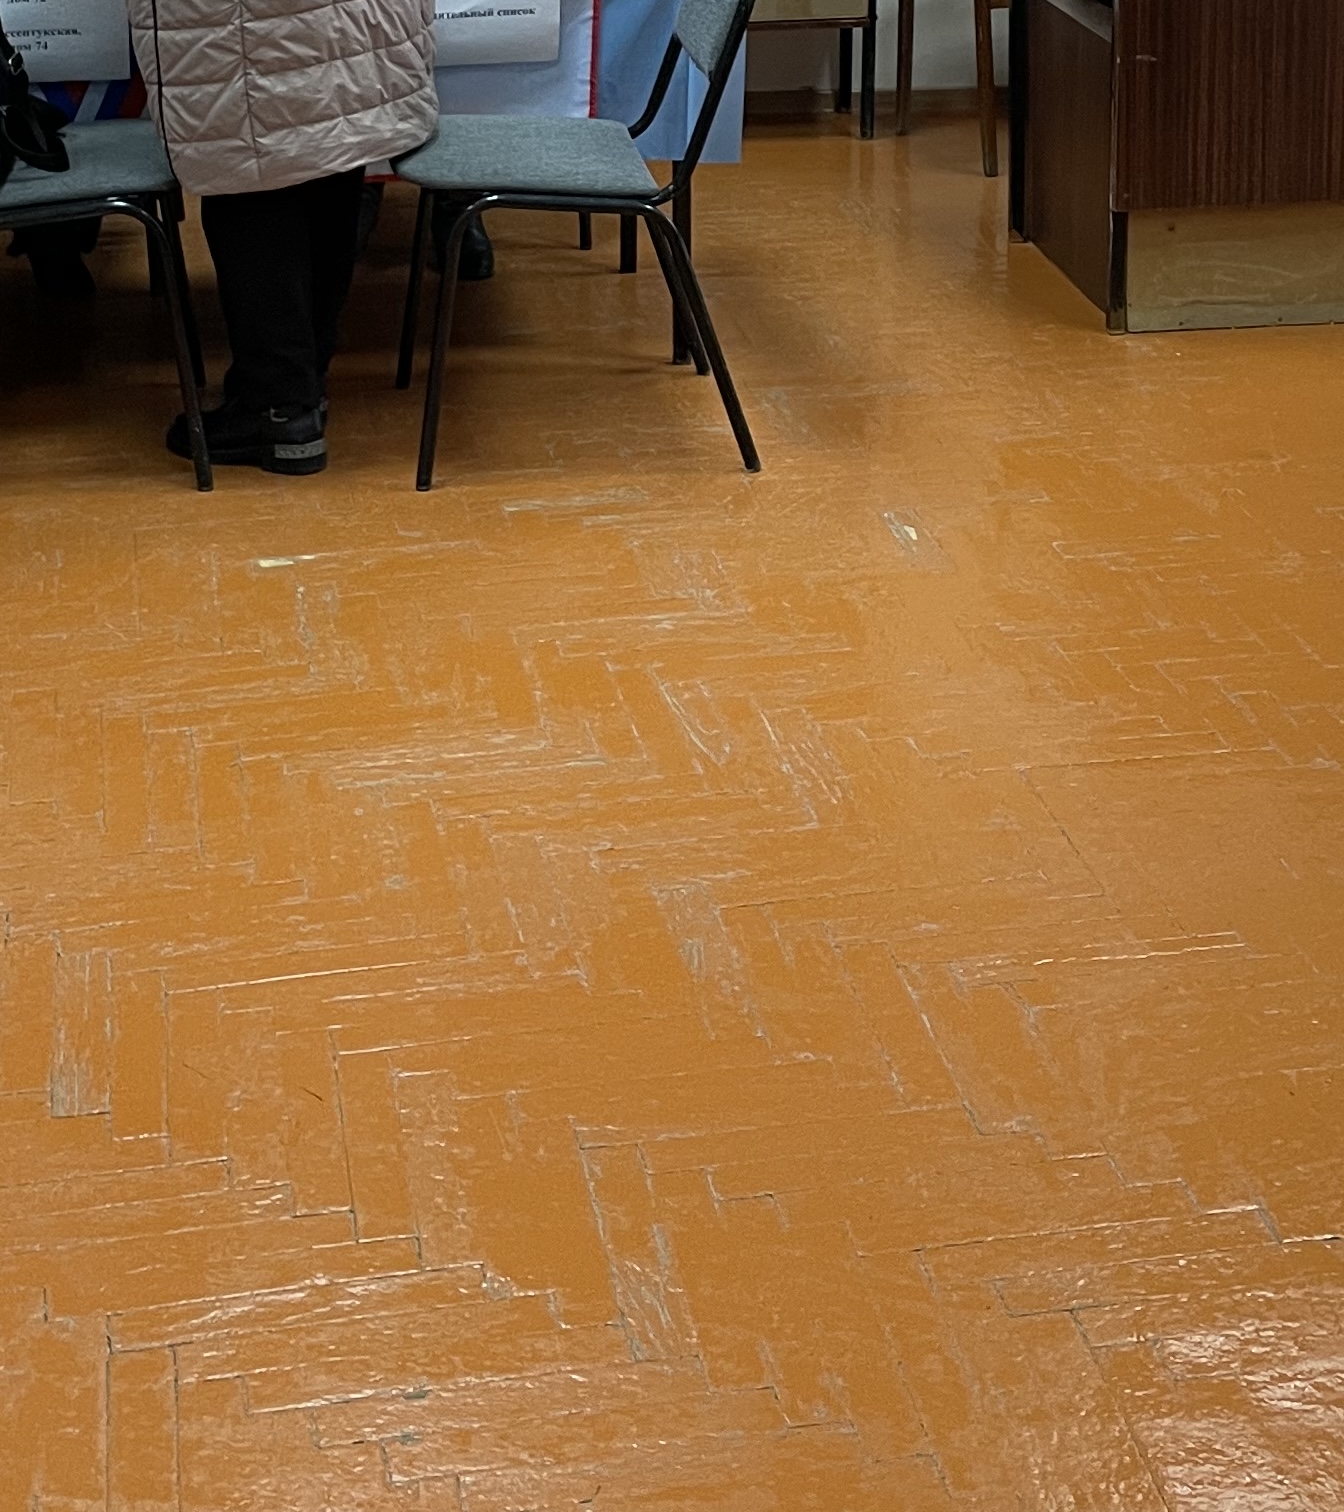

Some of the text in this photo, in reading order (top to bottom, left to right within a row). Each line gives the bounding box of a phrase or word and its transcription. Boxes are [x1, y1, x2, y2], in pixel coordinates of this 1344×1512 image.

[497, 7, 536, 17] список
[5, 29, 82, 38] ссентукская,
[13, 41, 48, 52] ом 74
